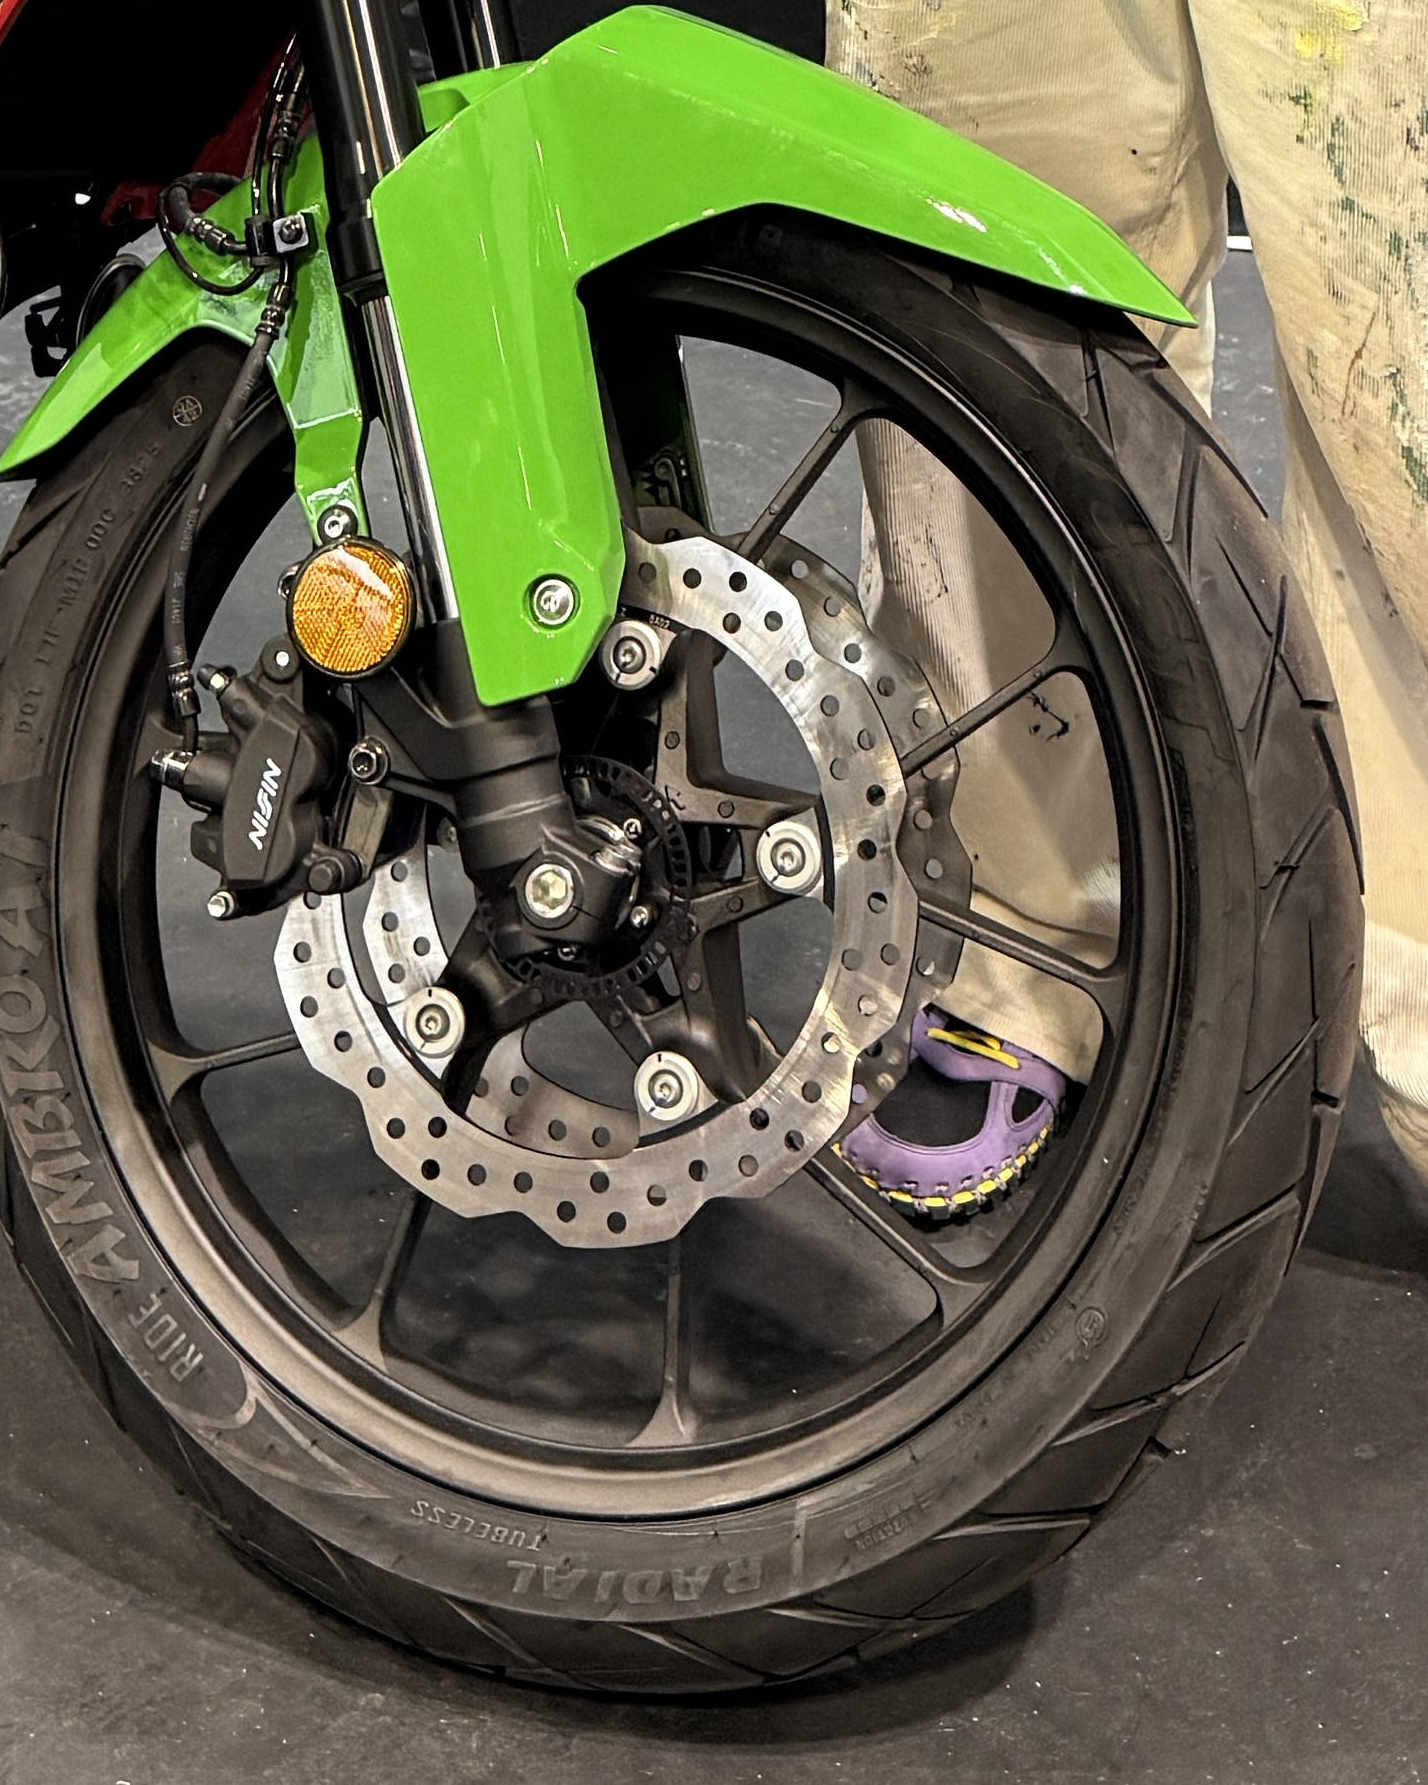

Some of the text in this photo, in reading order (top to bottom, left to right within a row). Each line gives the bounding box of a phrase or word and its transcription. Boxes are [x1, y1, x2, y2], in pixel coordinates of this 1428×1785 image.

[131, 1291, 204, 1383] RIDE
[409, 1498, 544, 1553] TUBELESS
[505, 1555, 767, 1606] RADIAL
